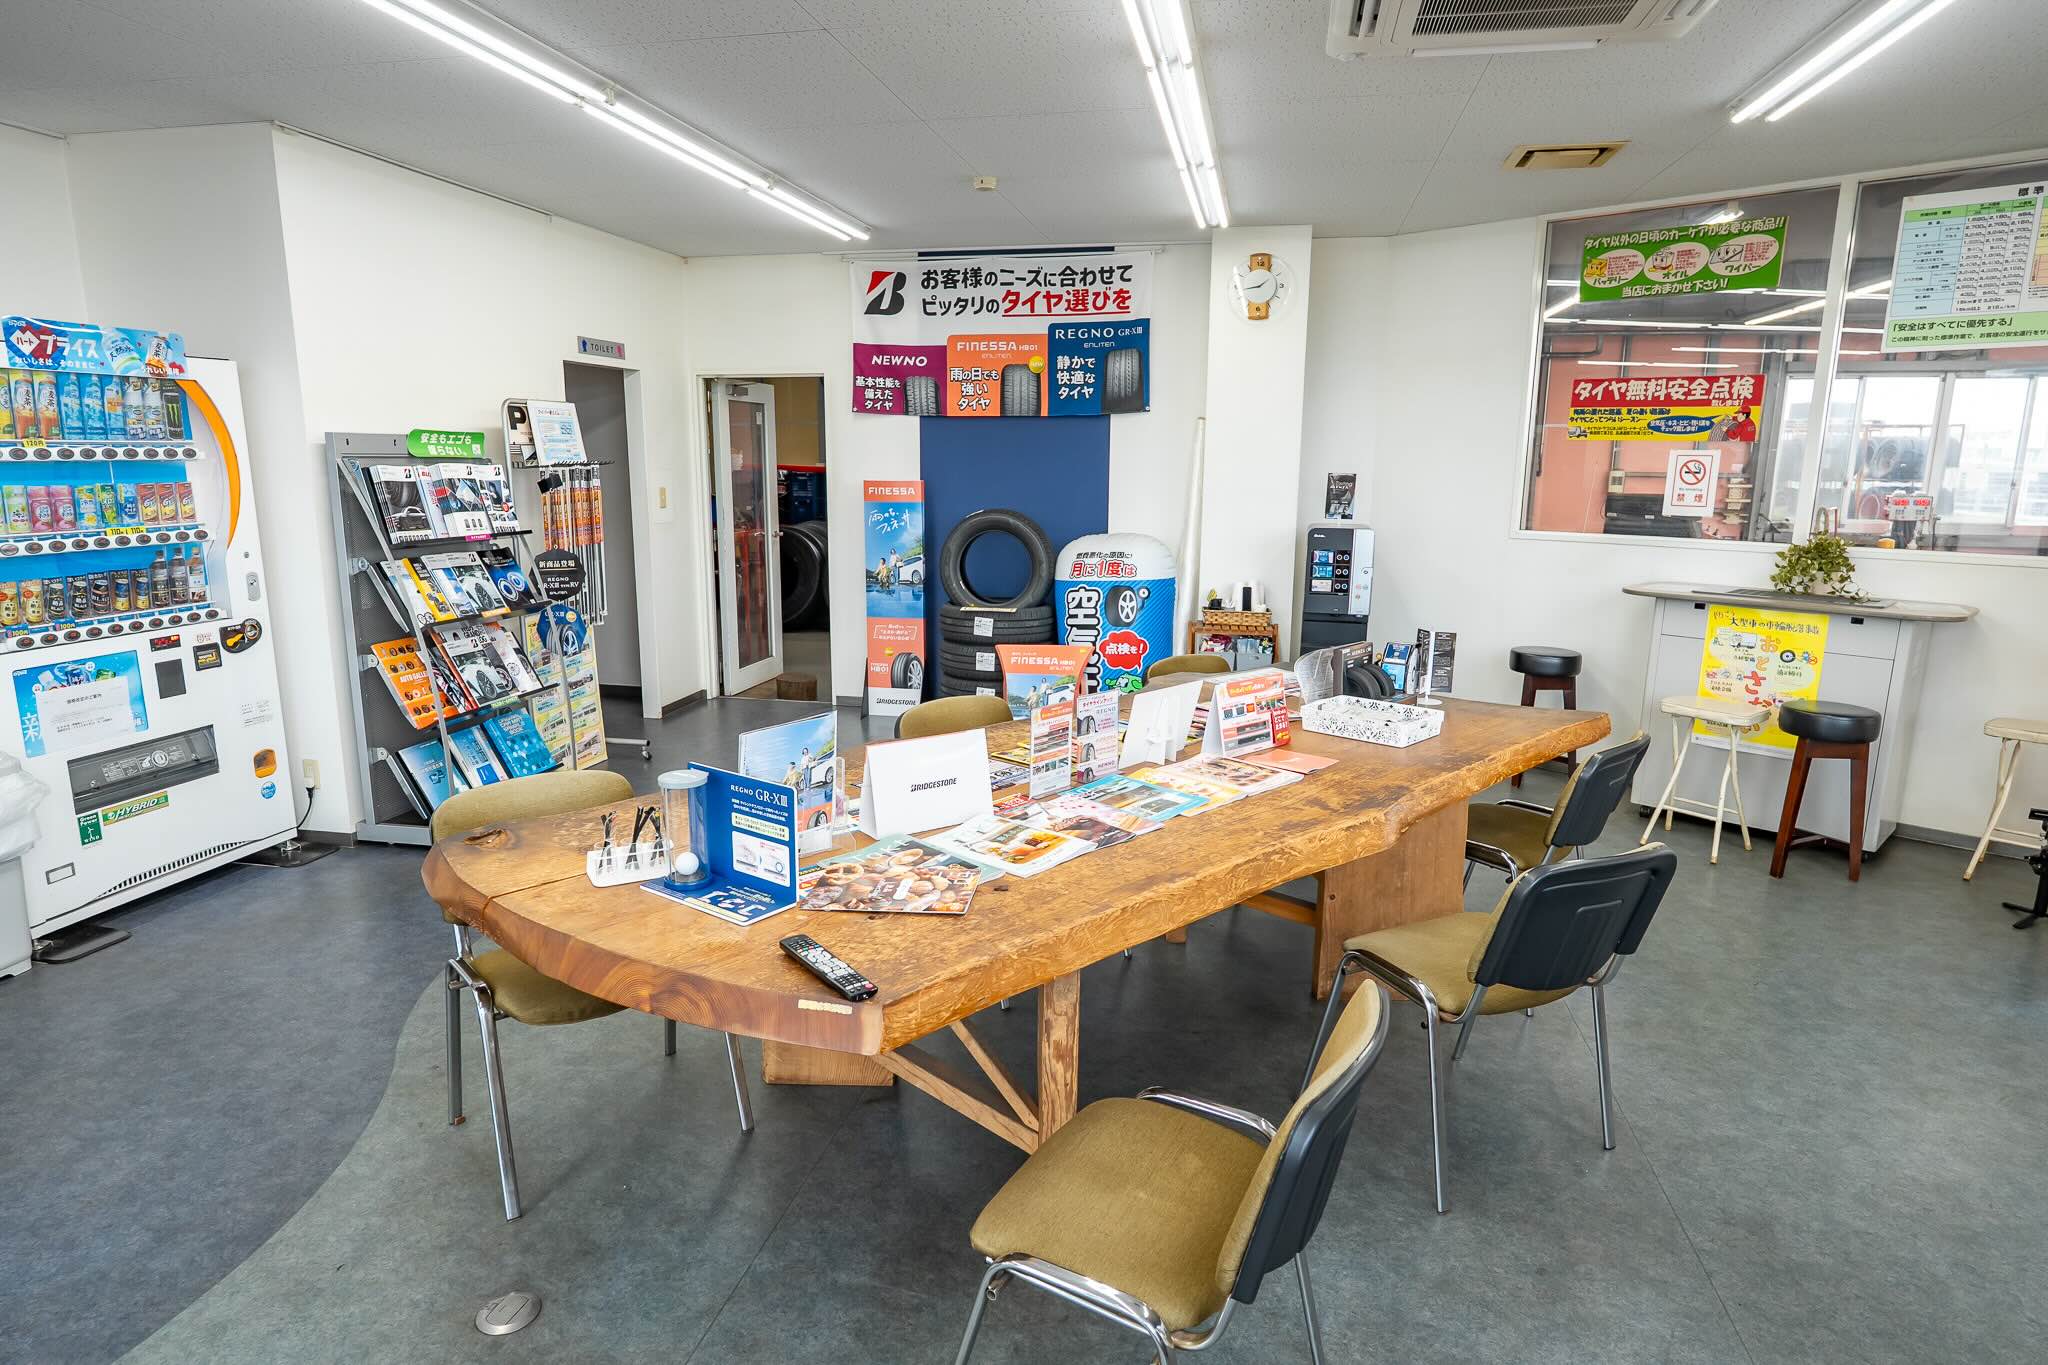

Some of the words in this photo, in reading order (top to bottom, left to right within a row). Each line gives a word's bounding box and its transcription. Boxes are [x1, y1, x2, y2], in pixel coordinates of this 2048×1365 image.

[1662, 270, 1689, 280] オイル
[1725, 263, 1762, 273] ワイパー
[920, 264, 1134, 290] お客様のニーズに合わせて
[921, 288, 1132, 316] ピッタリのタイヤ選びを
[1893, 317, 2013, 332] 「安全はすべてに優先する」
[1055, 327, 1115, 340] REGNO
[16, 336, 35, 346] ハート
[39, 333, 100, 359] プライス
[956, 341, 1017, 352] FINESSA
[590, 343, 614, 354] TOILET
[871, 354, 928, 368] NEWNO
[1056, 355, 1097, 370] 静かで
[949, 367, 1000, 381] 雨の日でも
[1056, 371, 1096, 386] 快適な
[855, 376, 901, 390] 基本性能を
[961, 381, 989, 396] 強い
[1575, 376, 1756, 401] タイヤ無料安全点検
[863, 388, 894, 401] 備えた
[1058, 385, 1095, 400] タイヤ
[863, 399, 894, 411] タイヤ
[957, 396, 992, 411] タイヤ
[420, 433, 472, 445] 安全もエコも
[868, 487, 916, 495] FINESSA
[539, 560, 575, 569] 新商品登場
[1071, 561, 1138, 577] 月に1度は
[1104, 642, 1145, 656] 点検を!
[1011, 657, 1058, 665] FINESSA
[876, 698, 917, 706] BRIDGESTONE
[730, 784, 753, 796] REGNO
[910, 776, 957, 793] BRIDGESTONE
[115, 798, 157, 820] HYBRID
[80, 814, 97, 822] Green
[80, 818, 98, 827] Power
